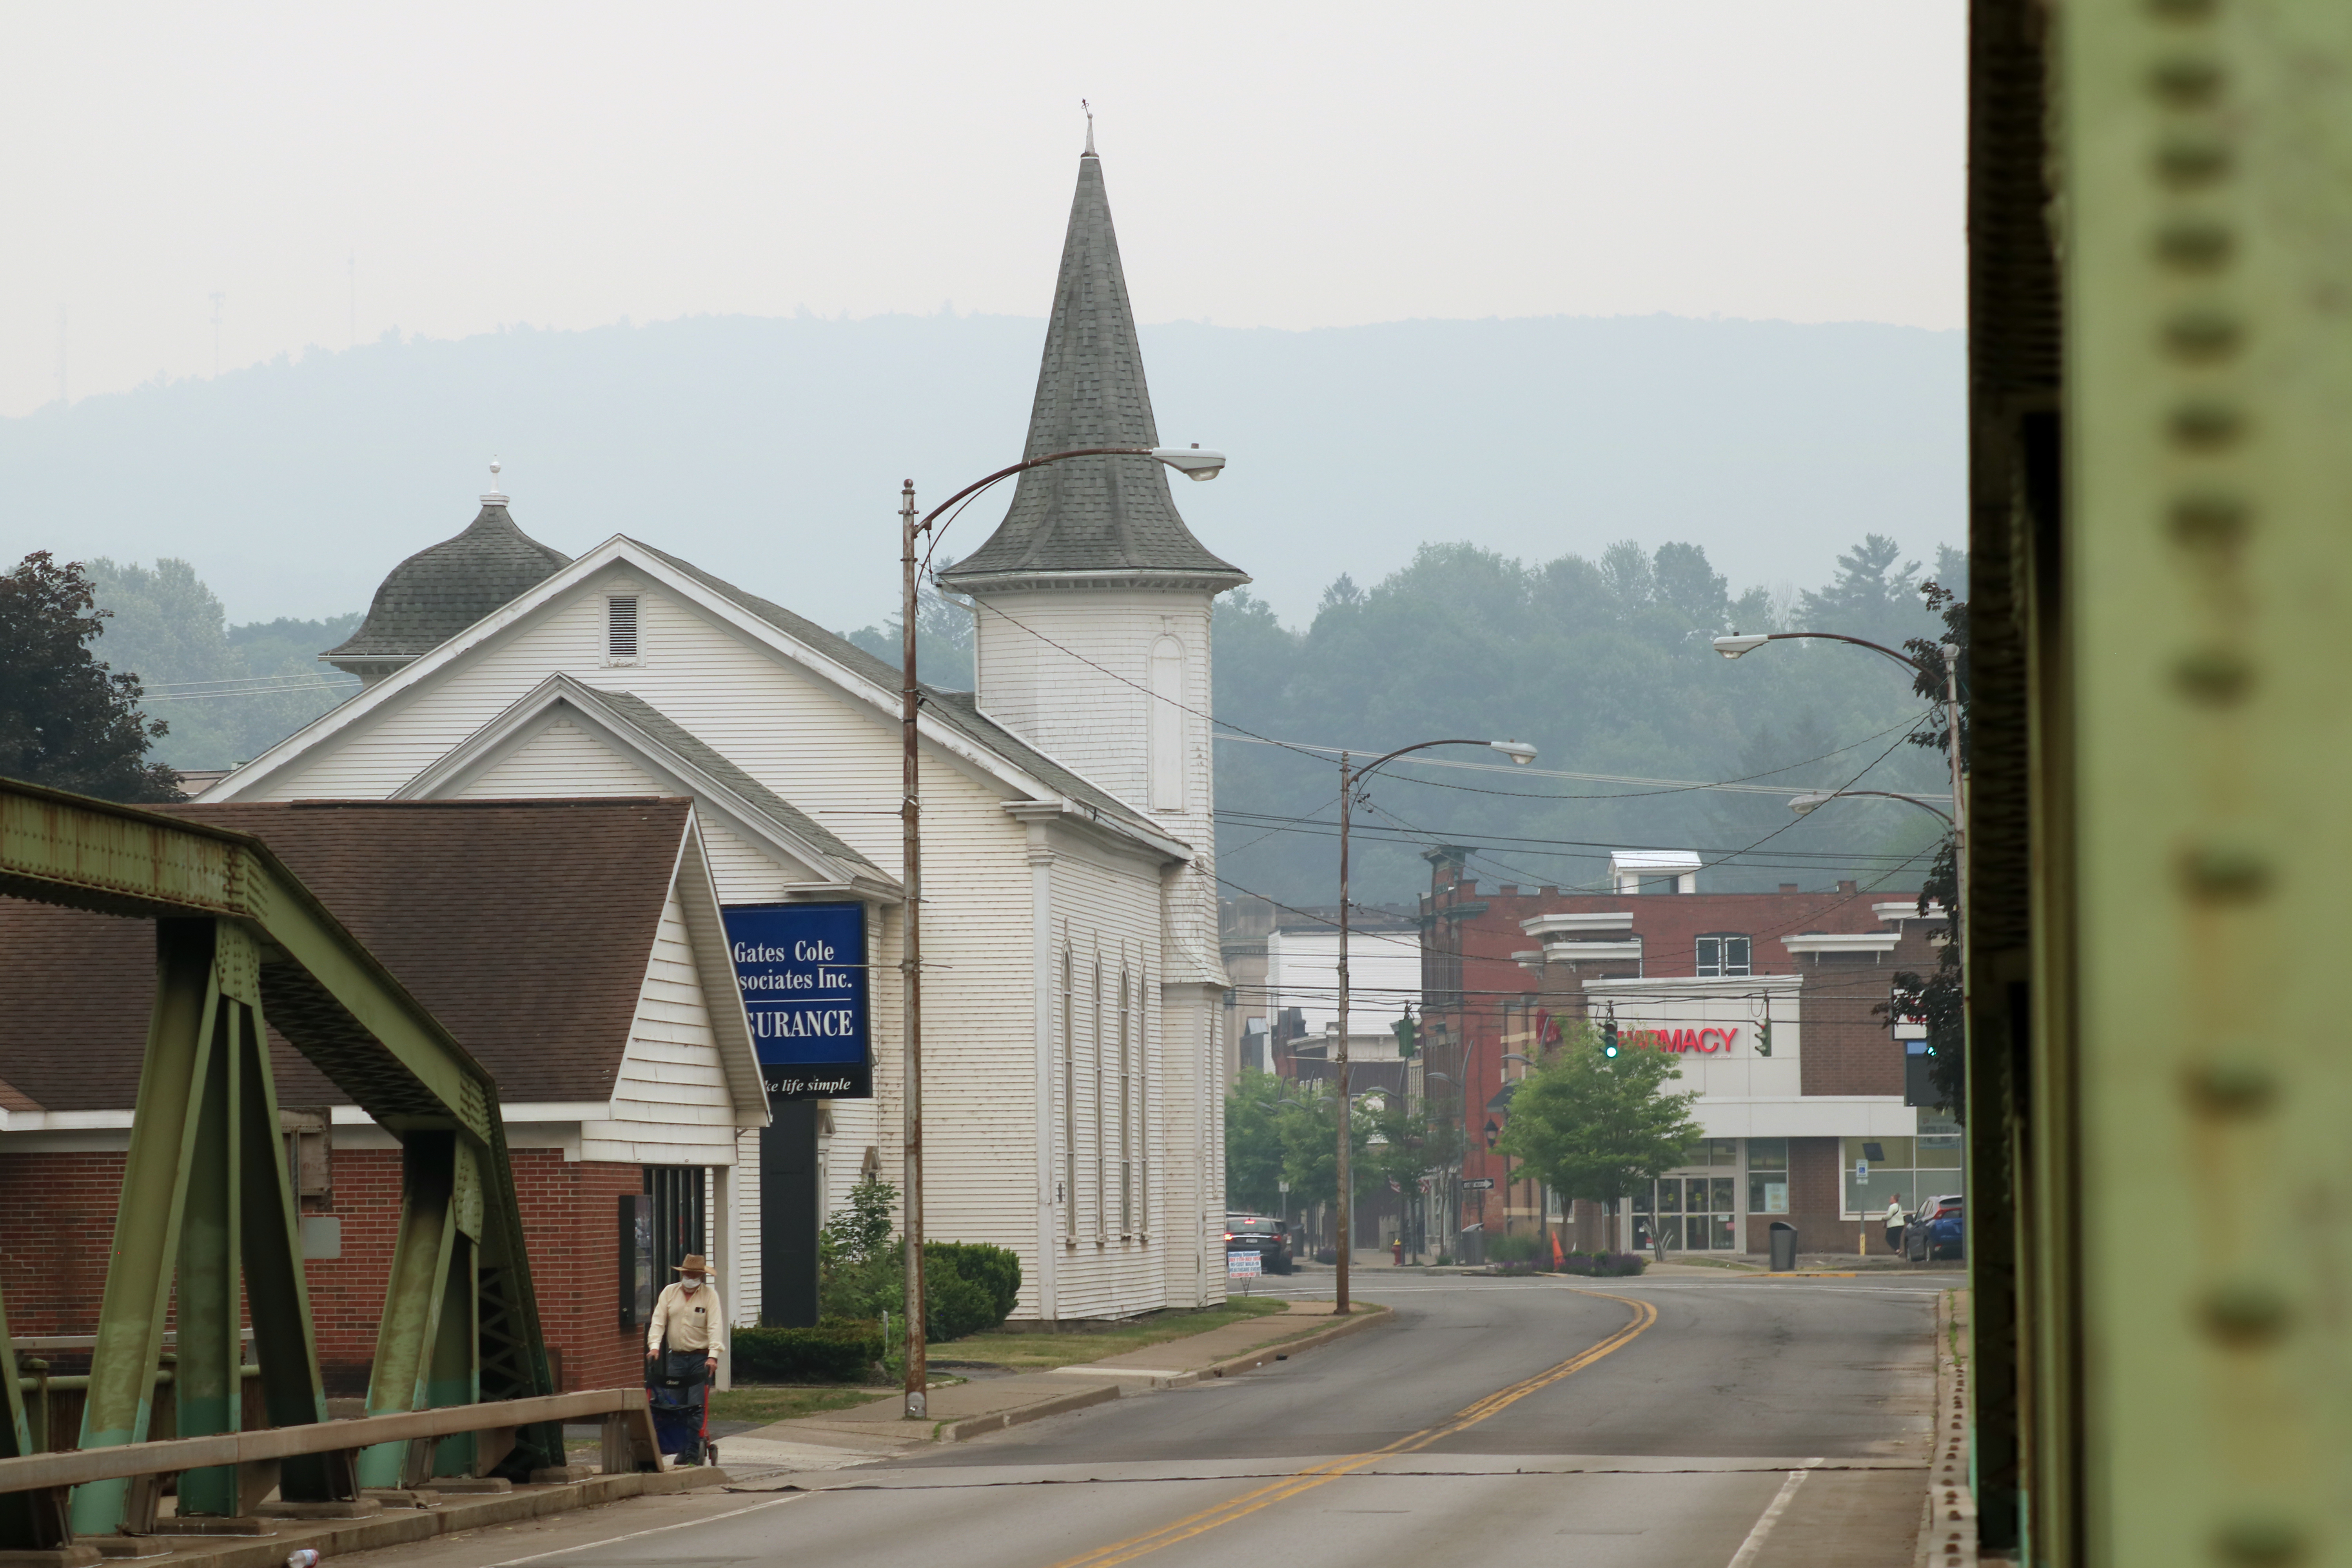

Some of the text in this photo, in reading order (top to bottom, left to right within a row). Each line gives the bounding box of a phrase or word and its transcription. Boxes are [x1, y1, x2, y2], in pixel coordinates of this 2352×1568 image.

[734, 940, 834, 963] Gates Cole
[818, 967, 853, 989] Inc.
[782, 1079, 804, 1094] life
[807, 1078, 851, 1094] simple
